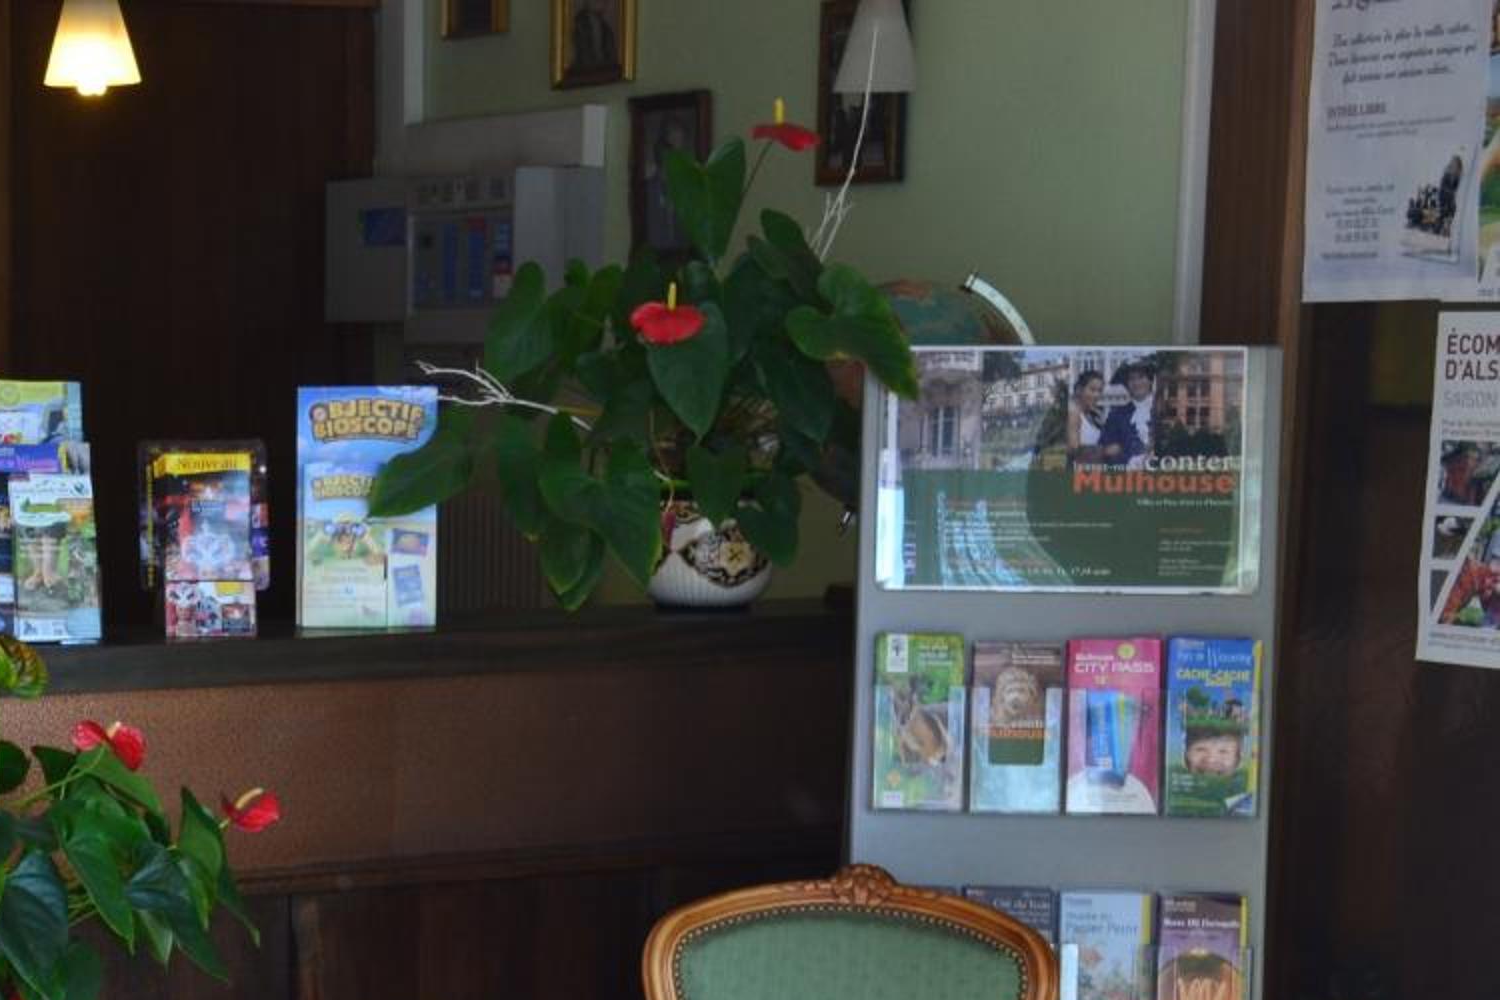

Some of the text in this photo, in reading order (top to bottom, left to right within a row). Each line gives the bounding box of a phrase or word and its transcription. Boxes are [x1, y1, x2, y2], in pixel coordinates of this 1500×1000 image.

[1447, 327, 1500, 355] ÉCOM
[1445, 359, 1500, 381] D'ALS
[309, 399, 427, 425] OBJECTIF
[313, 416, 421, 439] BIOSCOPE
[1073, 471, 1236, 495] Mulhouse
[1074, 661, 1156, 673] CITY PASS
